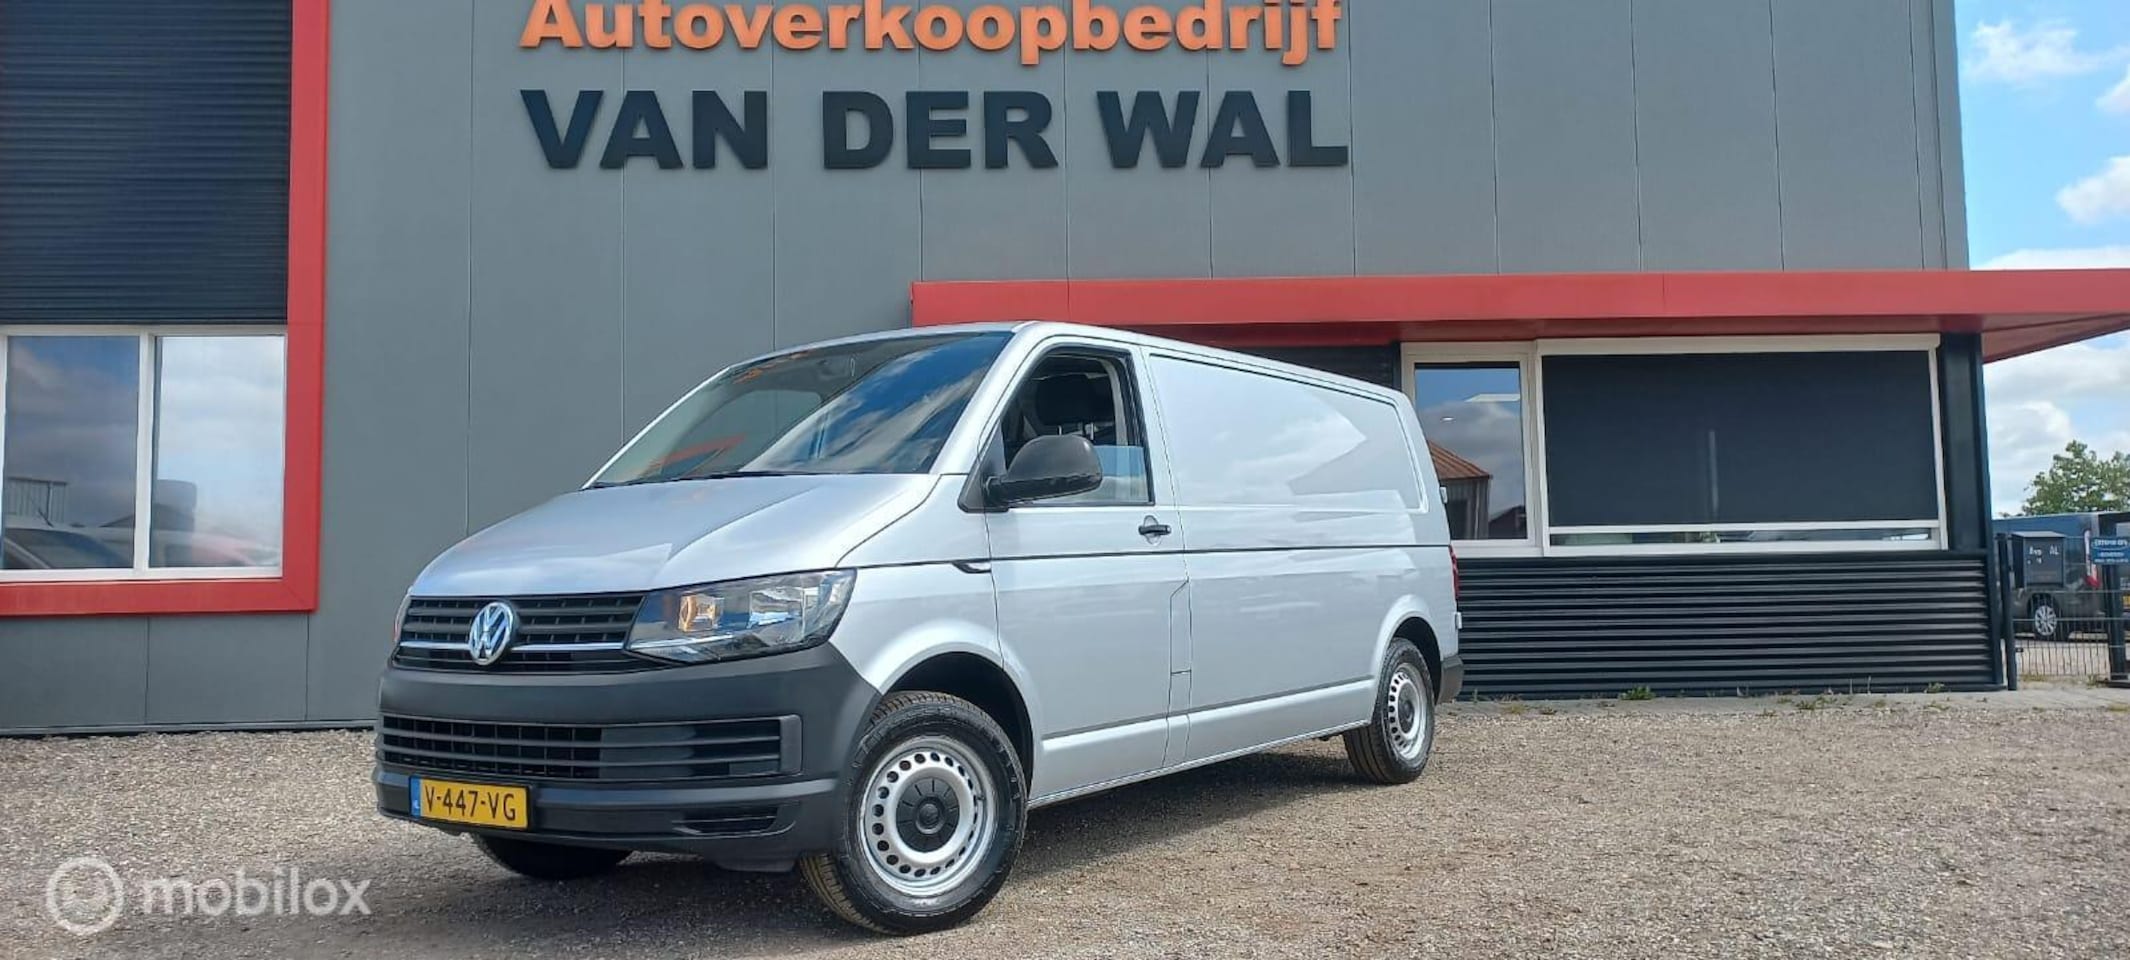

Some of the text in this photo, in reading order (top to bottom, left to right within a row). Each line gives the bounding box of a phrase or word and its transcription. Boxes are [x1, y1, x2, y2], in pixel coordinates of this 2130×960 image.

[519, 0, 1341, 65] Autoverkoopbedrijf
[520, 89, 1349, 170] VAN DER WAL
[424, 785, 516, 821] V-447-VG
